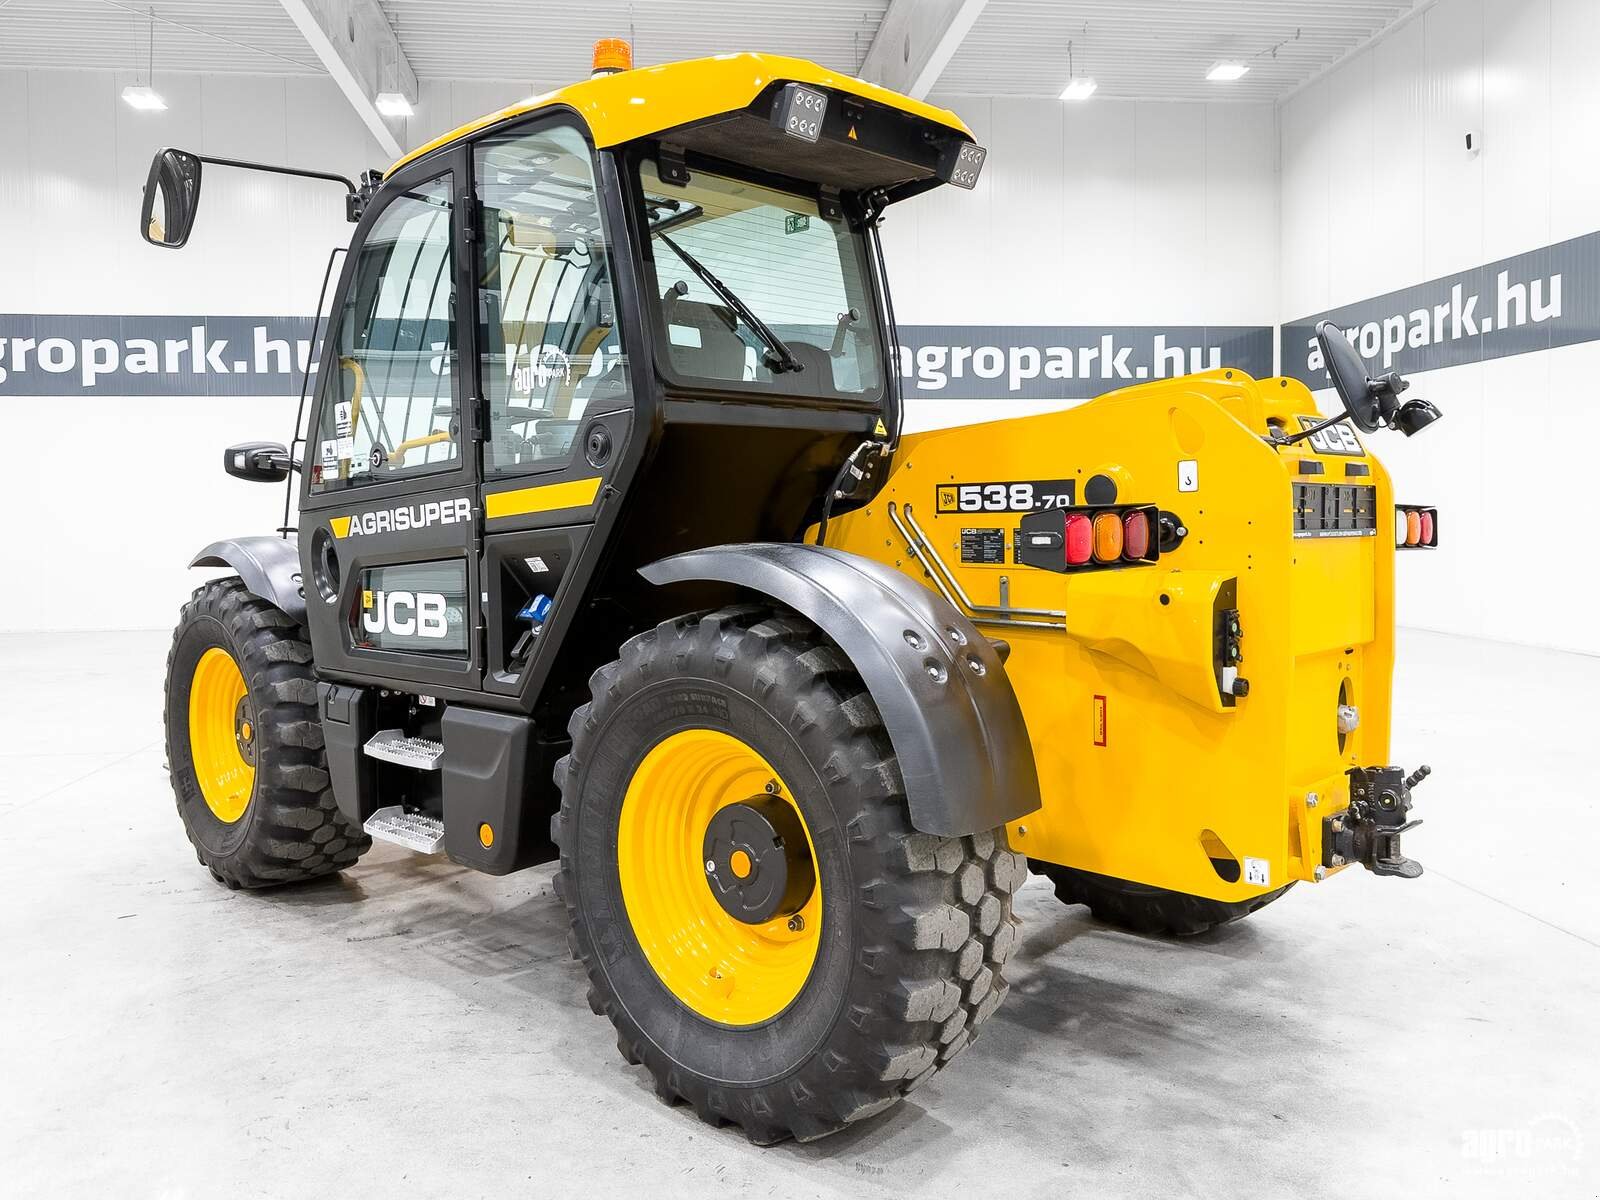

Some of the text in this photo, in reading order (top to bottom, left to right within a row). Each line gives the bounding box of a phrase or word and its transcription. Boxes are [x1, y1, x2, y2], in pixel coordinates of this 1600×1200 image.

[1307, 270, 1562, 379] aropark.hu
[0, 326, 324, 387] ropark.hu
[1309, 420, 1362, 452] JCB
[349, 497, 472, 537] AGRISUPER
[363, 590, 448, 638] JCB
